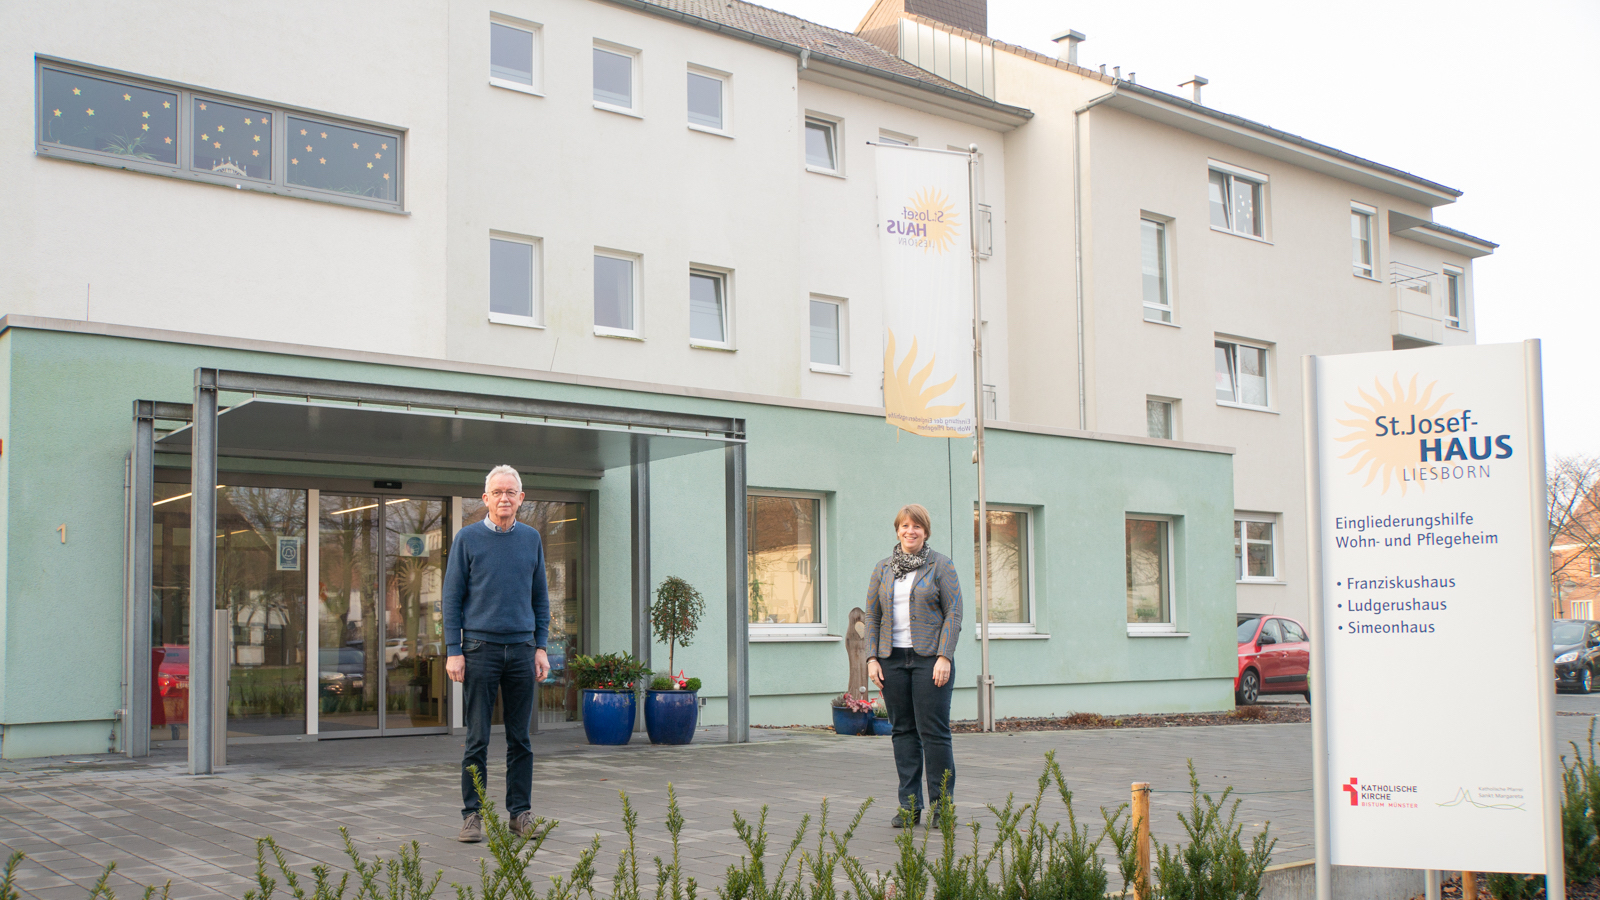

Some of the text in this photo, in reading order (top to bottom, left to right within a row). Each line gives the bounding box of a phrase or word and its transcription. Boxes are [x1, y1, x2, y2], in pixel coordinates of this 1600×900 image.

[1419, 434, 1513, 463] HAUS
[1403, 465, 1491, 482] LIESBORN
[1335, 512, 1474, 532] Eingliederungshilfe
[56, 523, 66, 545] 1
[1335, 531, 1499, 549] Wohn- und Pflegeheim
[1347, 575, 1456, 590] Franziskushaus
[1348, 598, 1447, 615] Ludgerushaus
[1348, 620, 1435, 634] Simeonhaus
[1361, 784, 1418, 793] KATHOLISCHE
[1388, 801, 1418, 809] MÜNSTER
